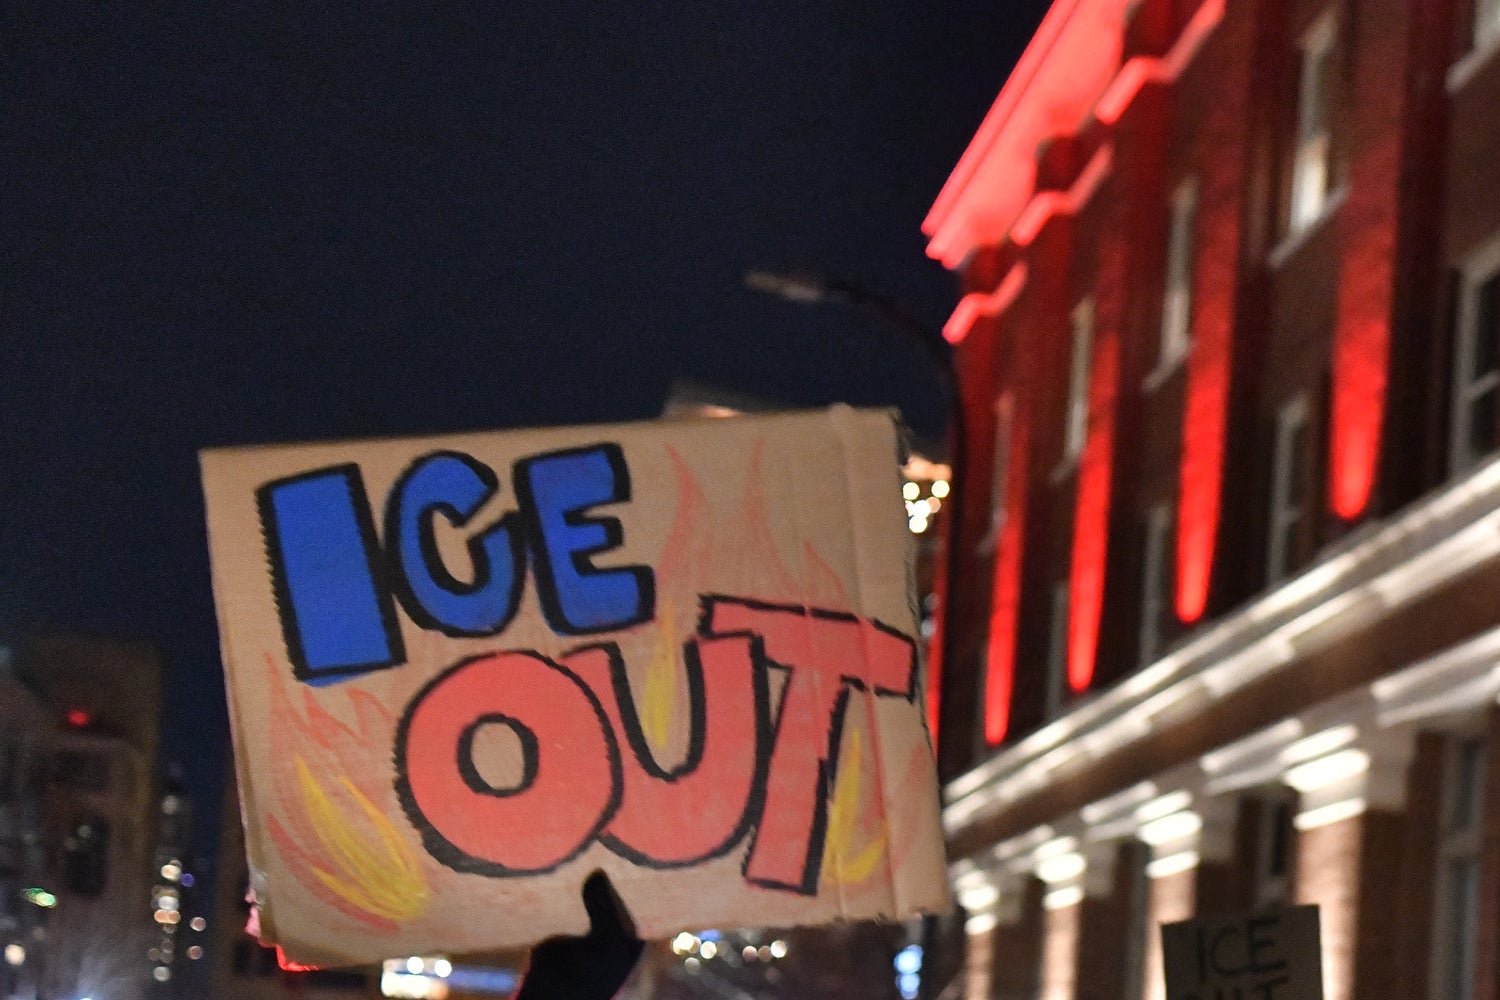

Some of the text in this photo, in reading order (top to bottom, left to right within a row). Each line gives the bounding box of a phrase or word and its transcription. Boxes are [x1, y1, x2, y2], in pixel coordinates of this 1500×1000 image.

[256, 441, 657, 687] ICE
[393, 591, 920, 897] OUT
[1194, 916, 1287, 984] ICE
